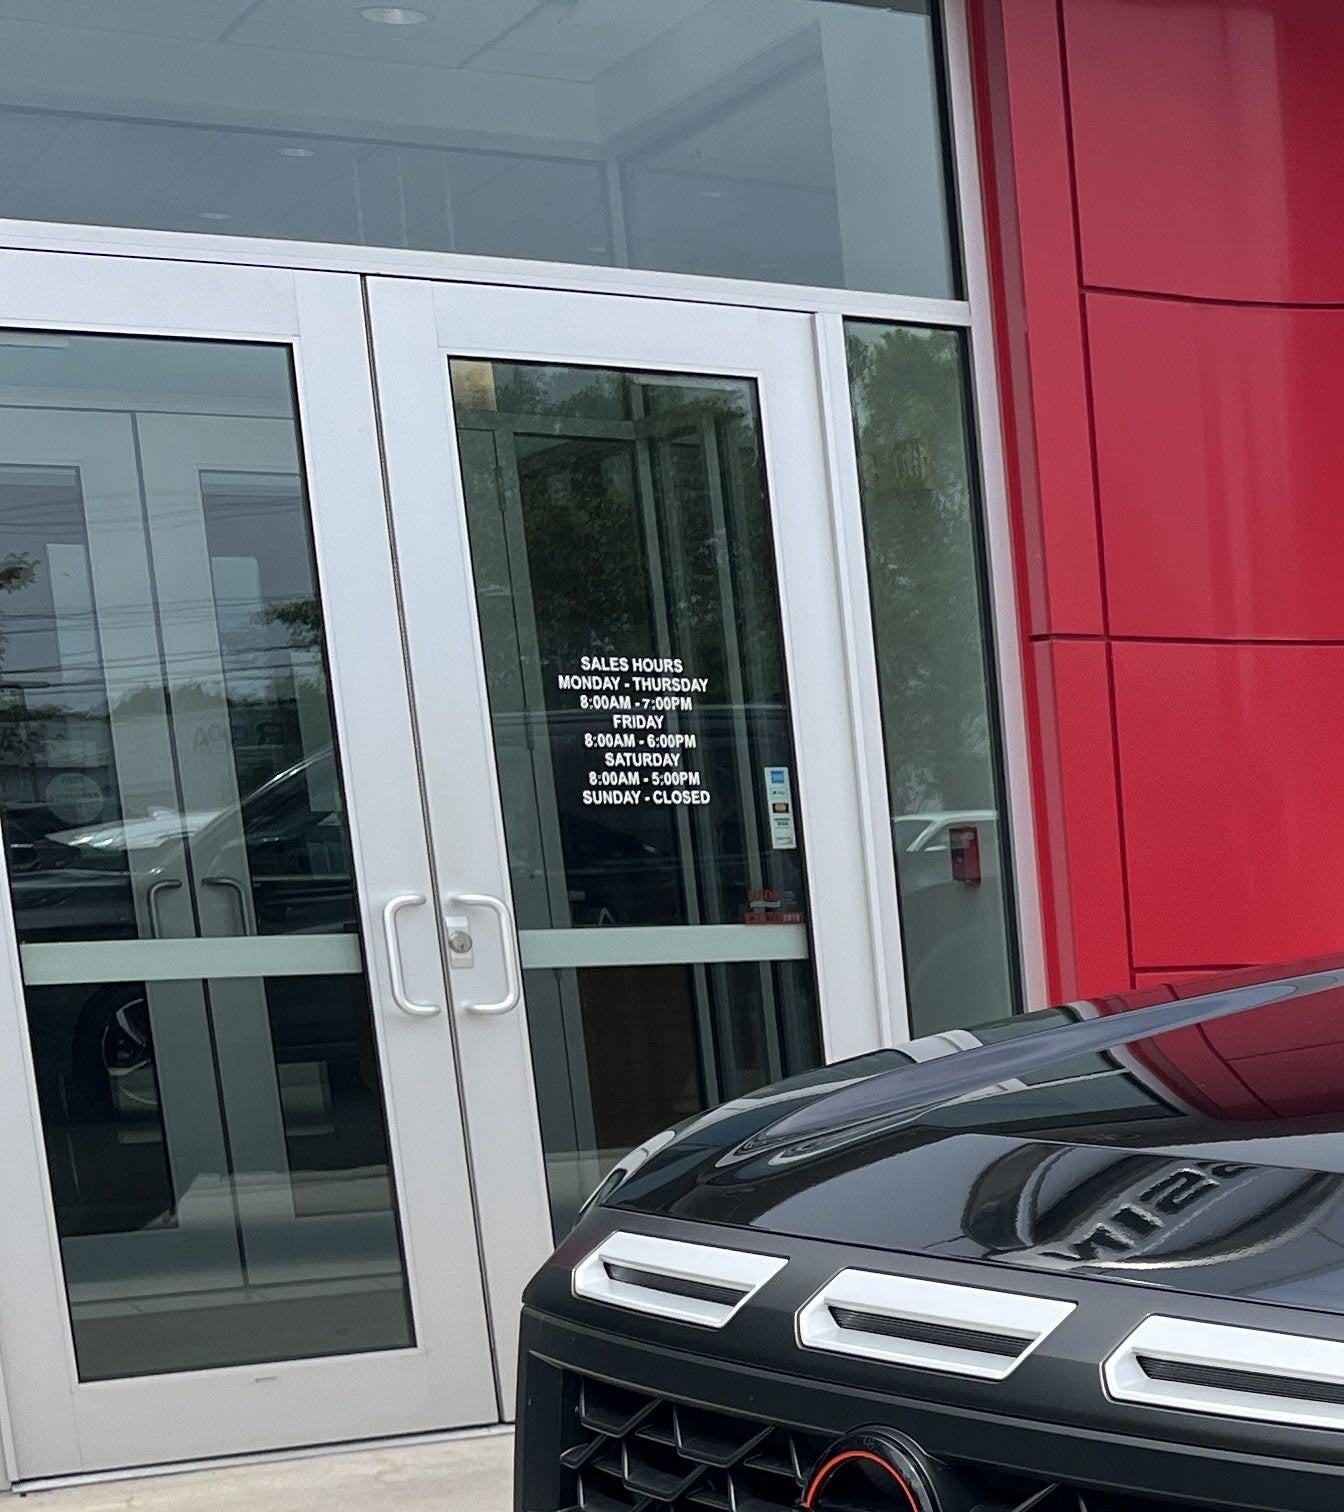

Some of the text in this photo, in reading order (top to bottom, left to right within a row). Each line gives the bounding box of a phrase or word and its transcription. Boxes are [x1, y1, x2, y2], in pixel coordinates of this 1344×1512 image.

[580, 656, 683, 673] SALES HOURS
[558, 675, 620, 690] MONDAY
[632, 677, 708, 692] THURSDAY
[580, 695, 631, 709] 8:00AM
[642, 696, 692, 710] 7:00PM
[612, 714, 664, 729] FRIDAY
[584, 733, 635, 747] 8:00AM
[647, 734, 696, 748] 6:00PM
[605, 752, 680, 767] SATURDAY
[588, 771, 640, 785] 8:00AM
[652, 771, 700, 785] 5:00PM
[582, 790, 641, 805] SUNDAY
[653, 790, 710, 805] CLOSED
